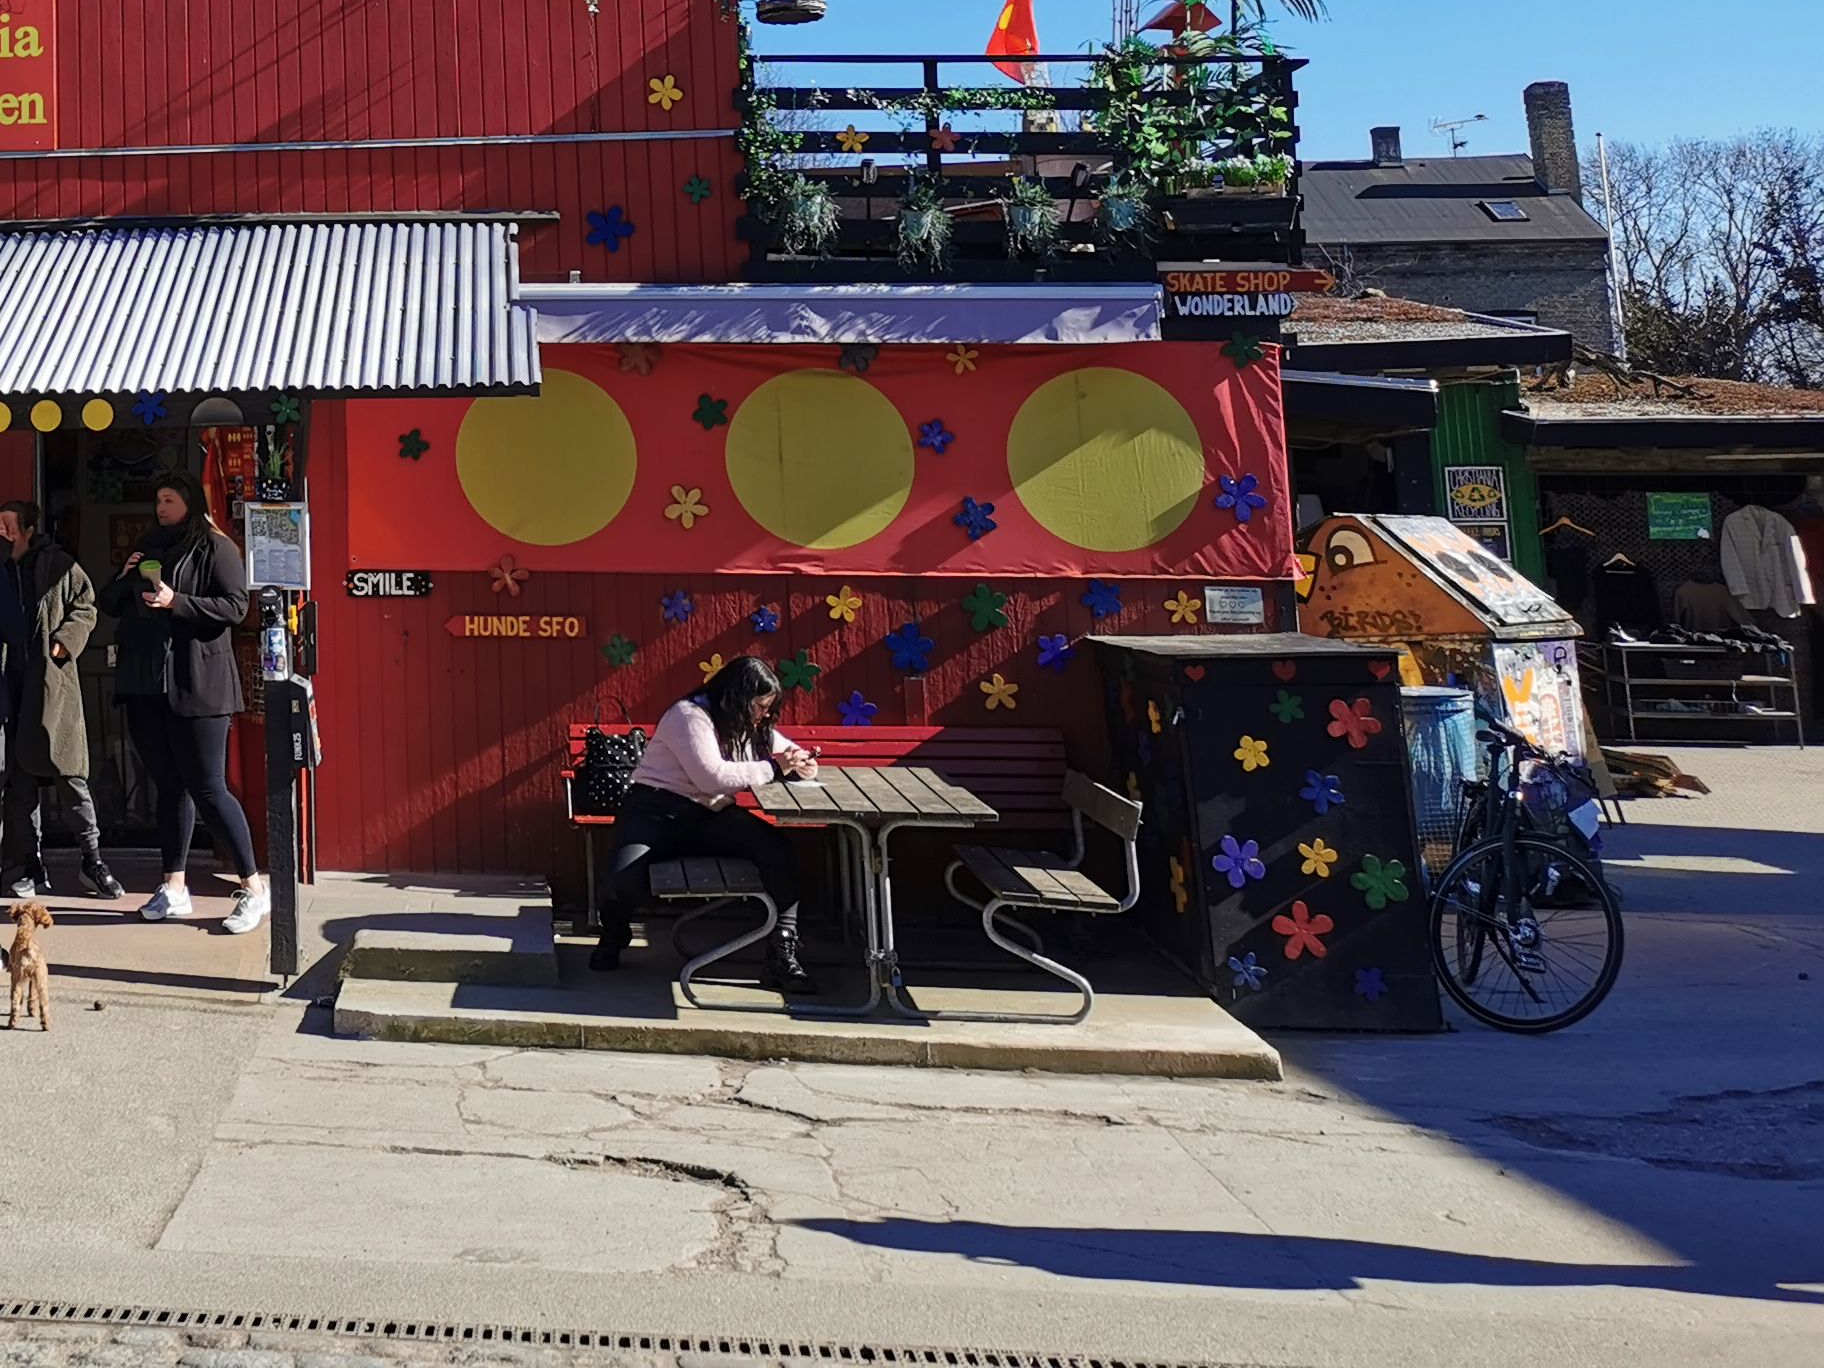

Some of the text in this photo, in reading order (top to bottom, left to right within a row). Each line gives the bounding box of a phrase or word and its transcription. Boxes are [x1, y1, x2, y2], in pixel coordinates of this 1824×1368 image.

[1166, 272, 1291, 292] SKATE SHOP
[1174, 293, 1293, 316] WONDERLAND
[353, 572, 414, 596] SMILE
[465, 615, 579, 637] HUNDE SFO
